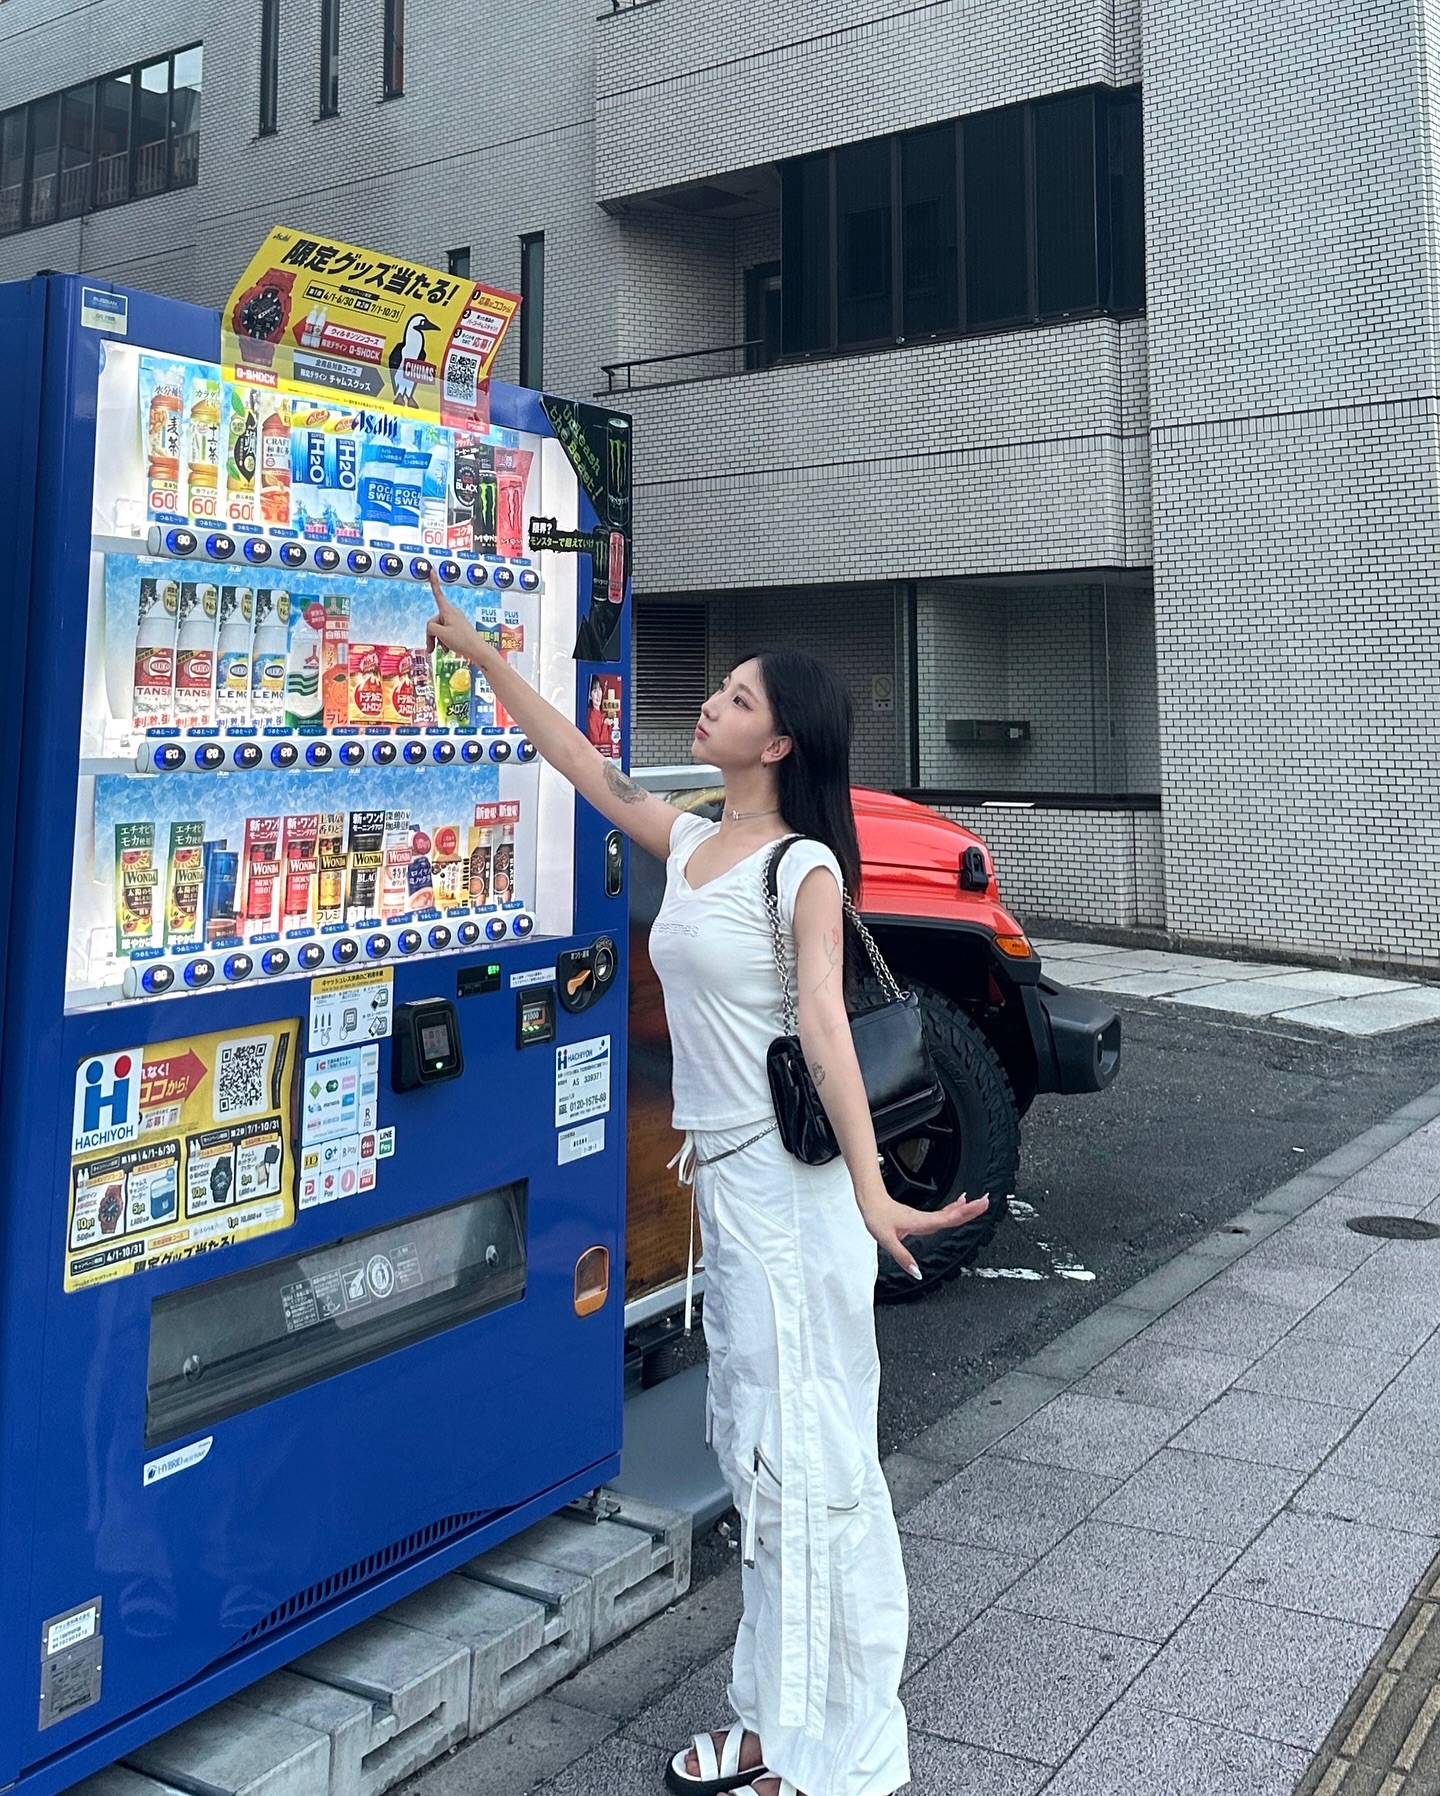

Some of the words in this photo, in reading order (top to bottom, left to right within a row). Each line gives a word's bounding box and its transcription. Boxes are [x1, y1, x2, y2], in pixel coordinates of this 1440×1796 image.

[280, 238, 460, 307] 限定グッズ当たる!
[404, 361, 435, 382] CHUMS
[351, 410, 399, 438] Asahi
[550, 404, 569, 442] the
[167, 415, 180, 456] 麦茶
[207, 423, 219, 464] 十六茶
[563, 404, 601, 477] Unleash
[455, 483, 478, 493] BLACK
[481, 608, 498, 616] PLUS
[290, 859, 317, 872] WONDA
[322, 856, 347, 869] WONDA
[356, 853, 382, 865] WONDA
[127, 871, 156, 884] WONDA
[252, 862, 280, 876] WONDA
[572, 1078, 580, 1087] AS
[75, 1124, 134, 1151] HACHIYOH
[380, 1129, 393, 1141] LINE
[105, 1243, 143, 1263] 4/1-10/31
